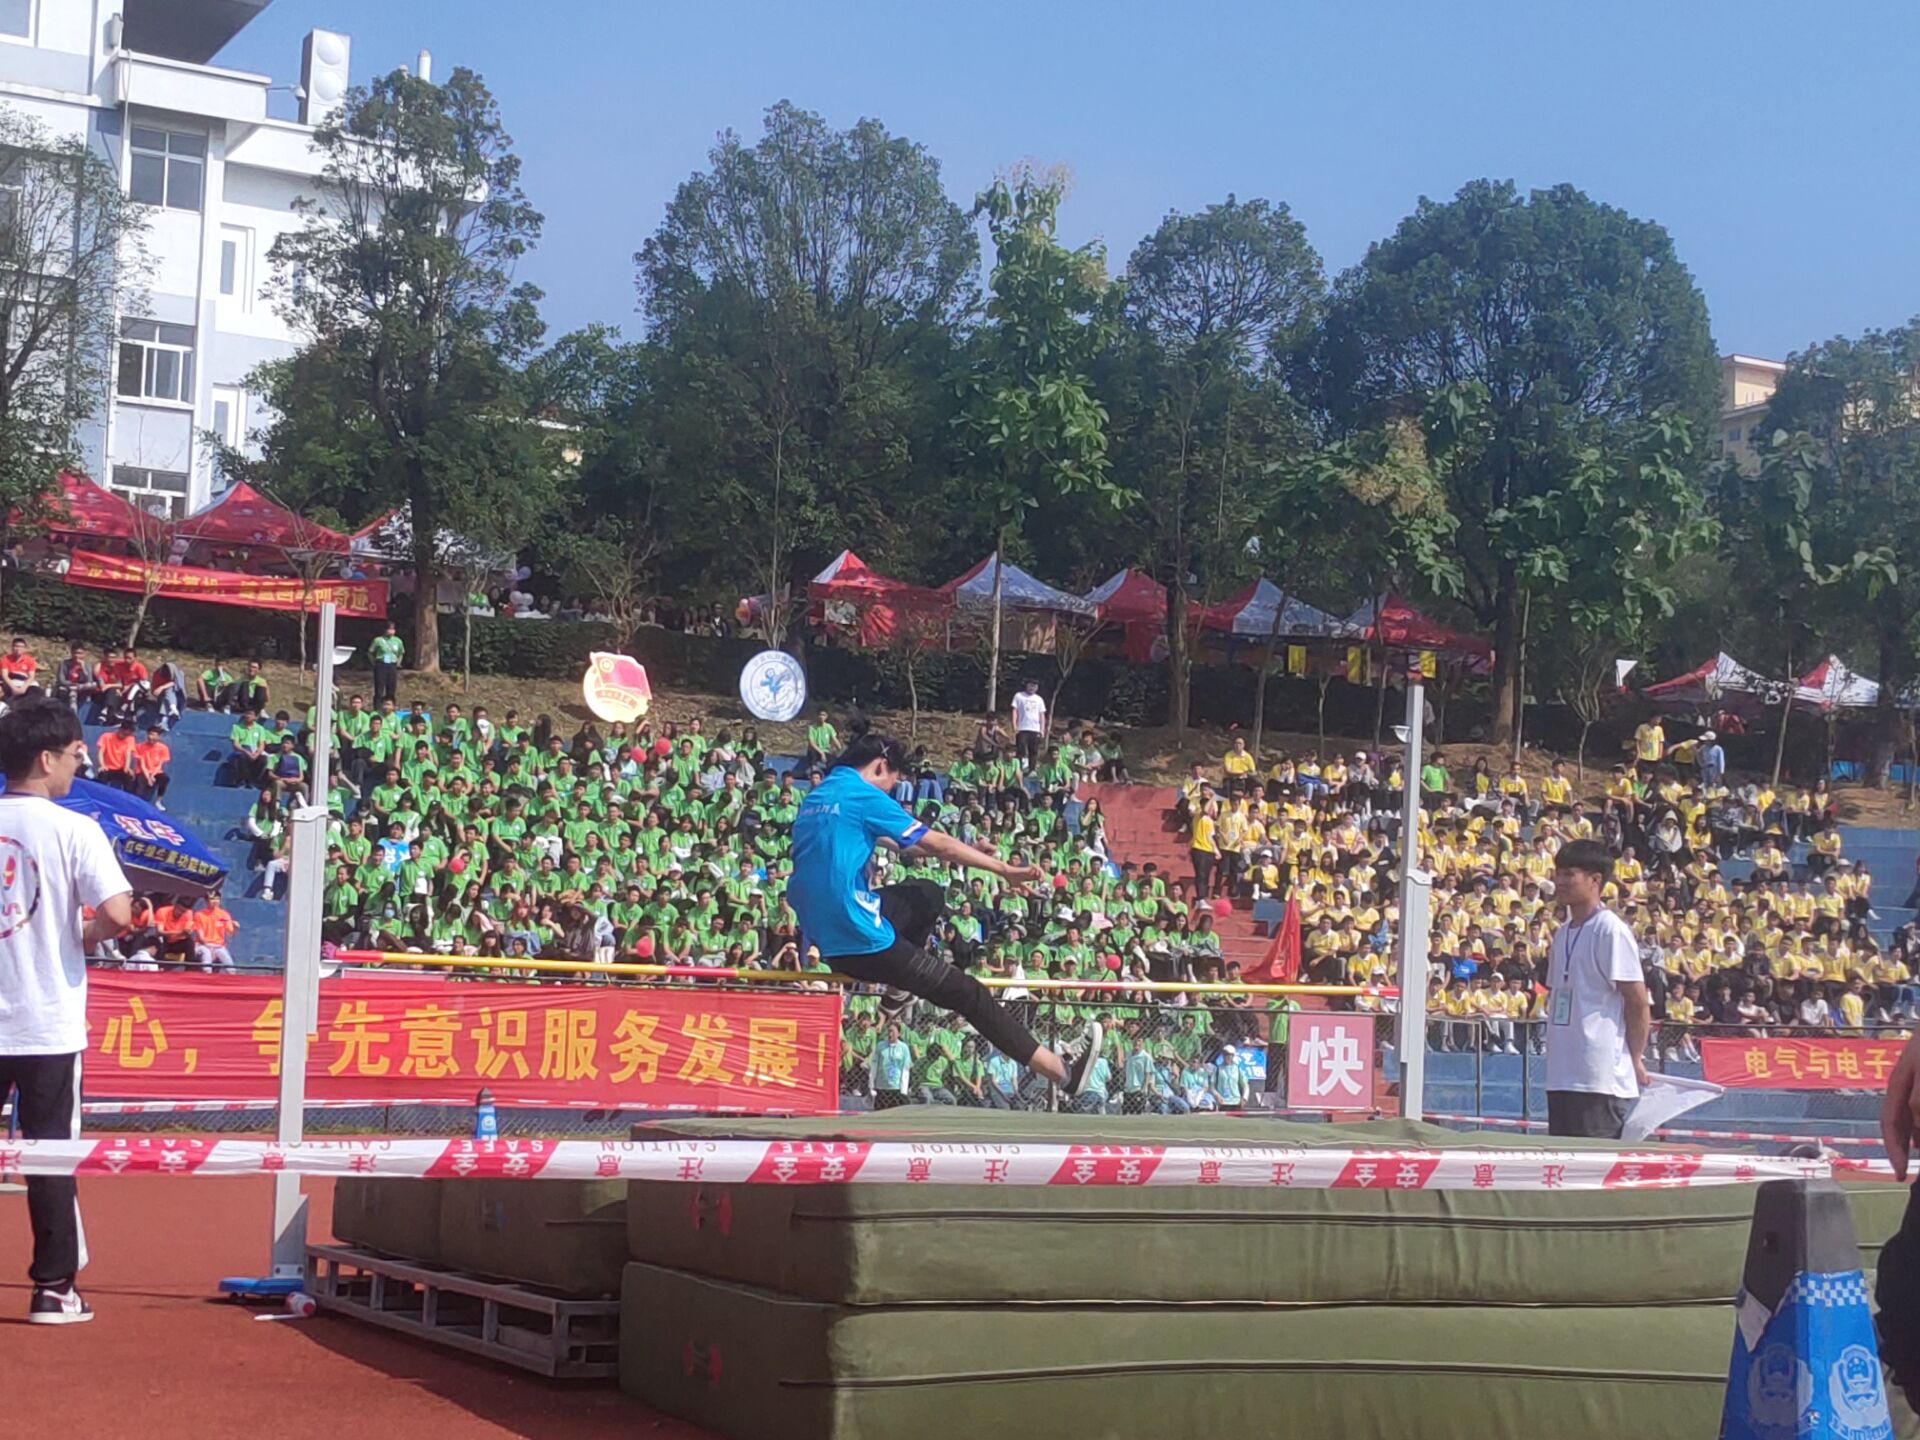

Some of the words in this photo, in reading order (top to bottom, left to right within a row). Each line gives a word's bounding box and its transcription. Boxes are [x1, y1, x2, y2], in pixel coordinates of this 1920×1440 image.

[86, 996, 825, 1087] 心，争先意识服务发展！
[1298, 1026, 1364, 1097] 快
[1744, 1046, 1902, 1080] 电气与电子
[460, 1139, 544, 1152] SAFE
[782, 1142, 859, 1154] SAFE
